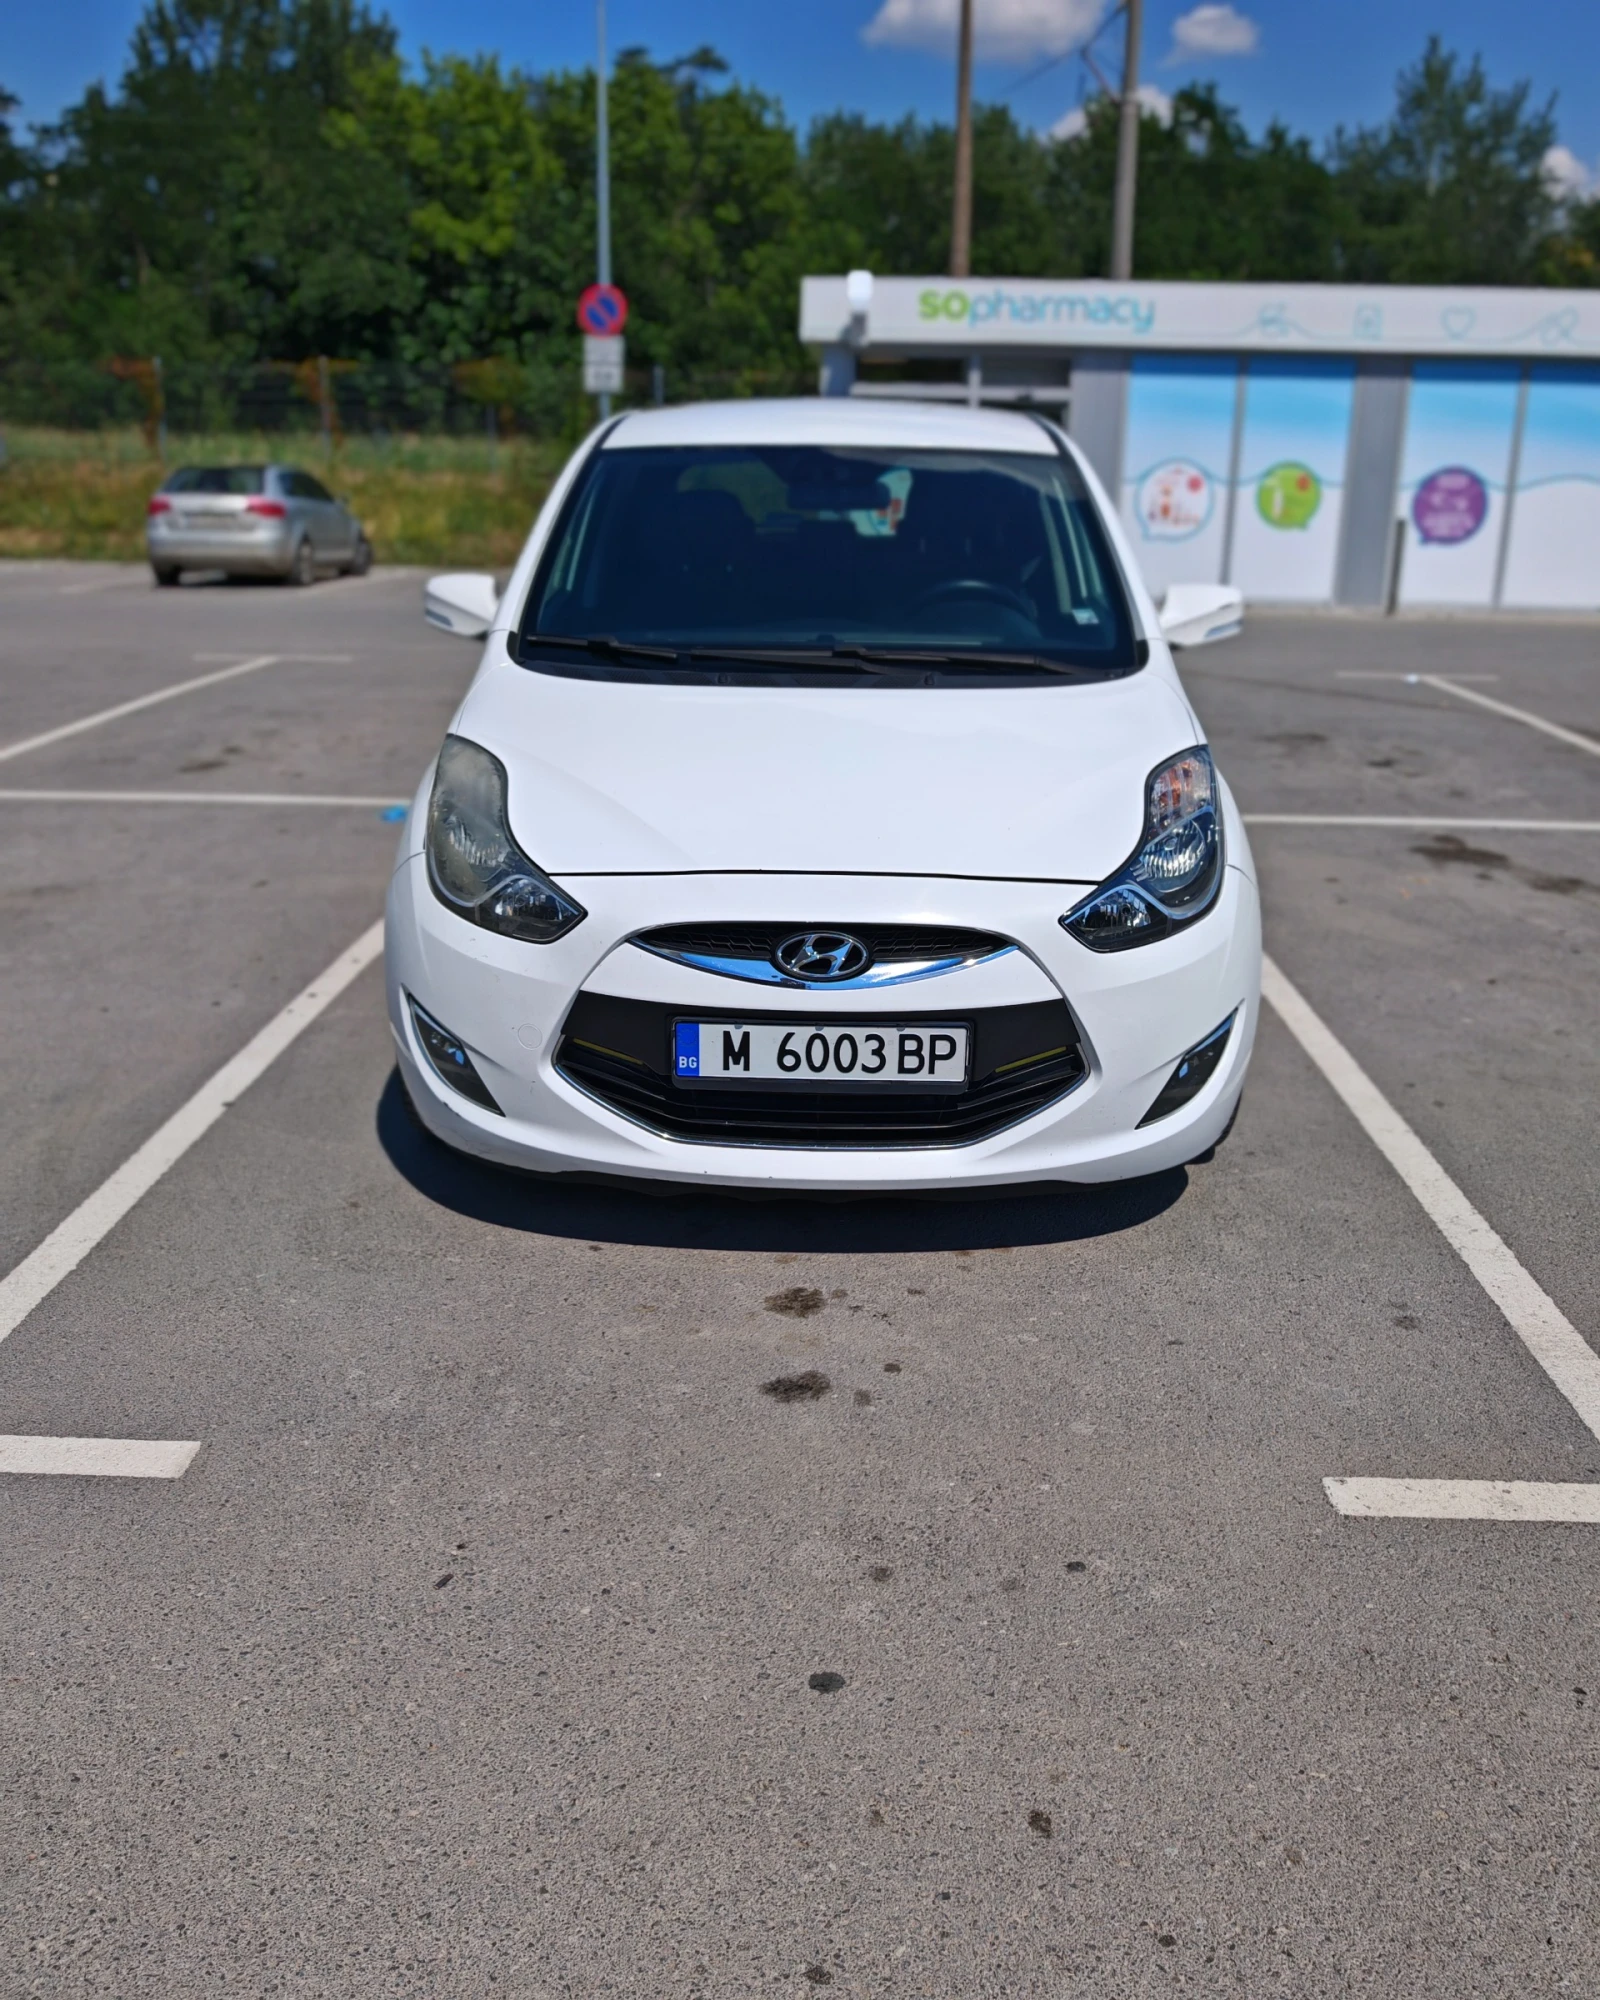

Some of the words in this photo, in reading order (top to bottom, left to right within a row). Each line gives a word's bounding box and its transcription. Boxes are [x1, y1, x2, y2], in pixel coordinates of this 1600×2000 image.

[918, 289, 1155, 333] sopharmacy
[679, 1056, 698, 1069] BG
[723, 1030, 750, 1072] M
